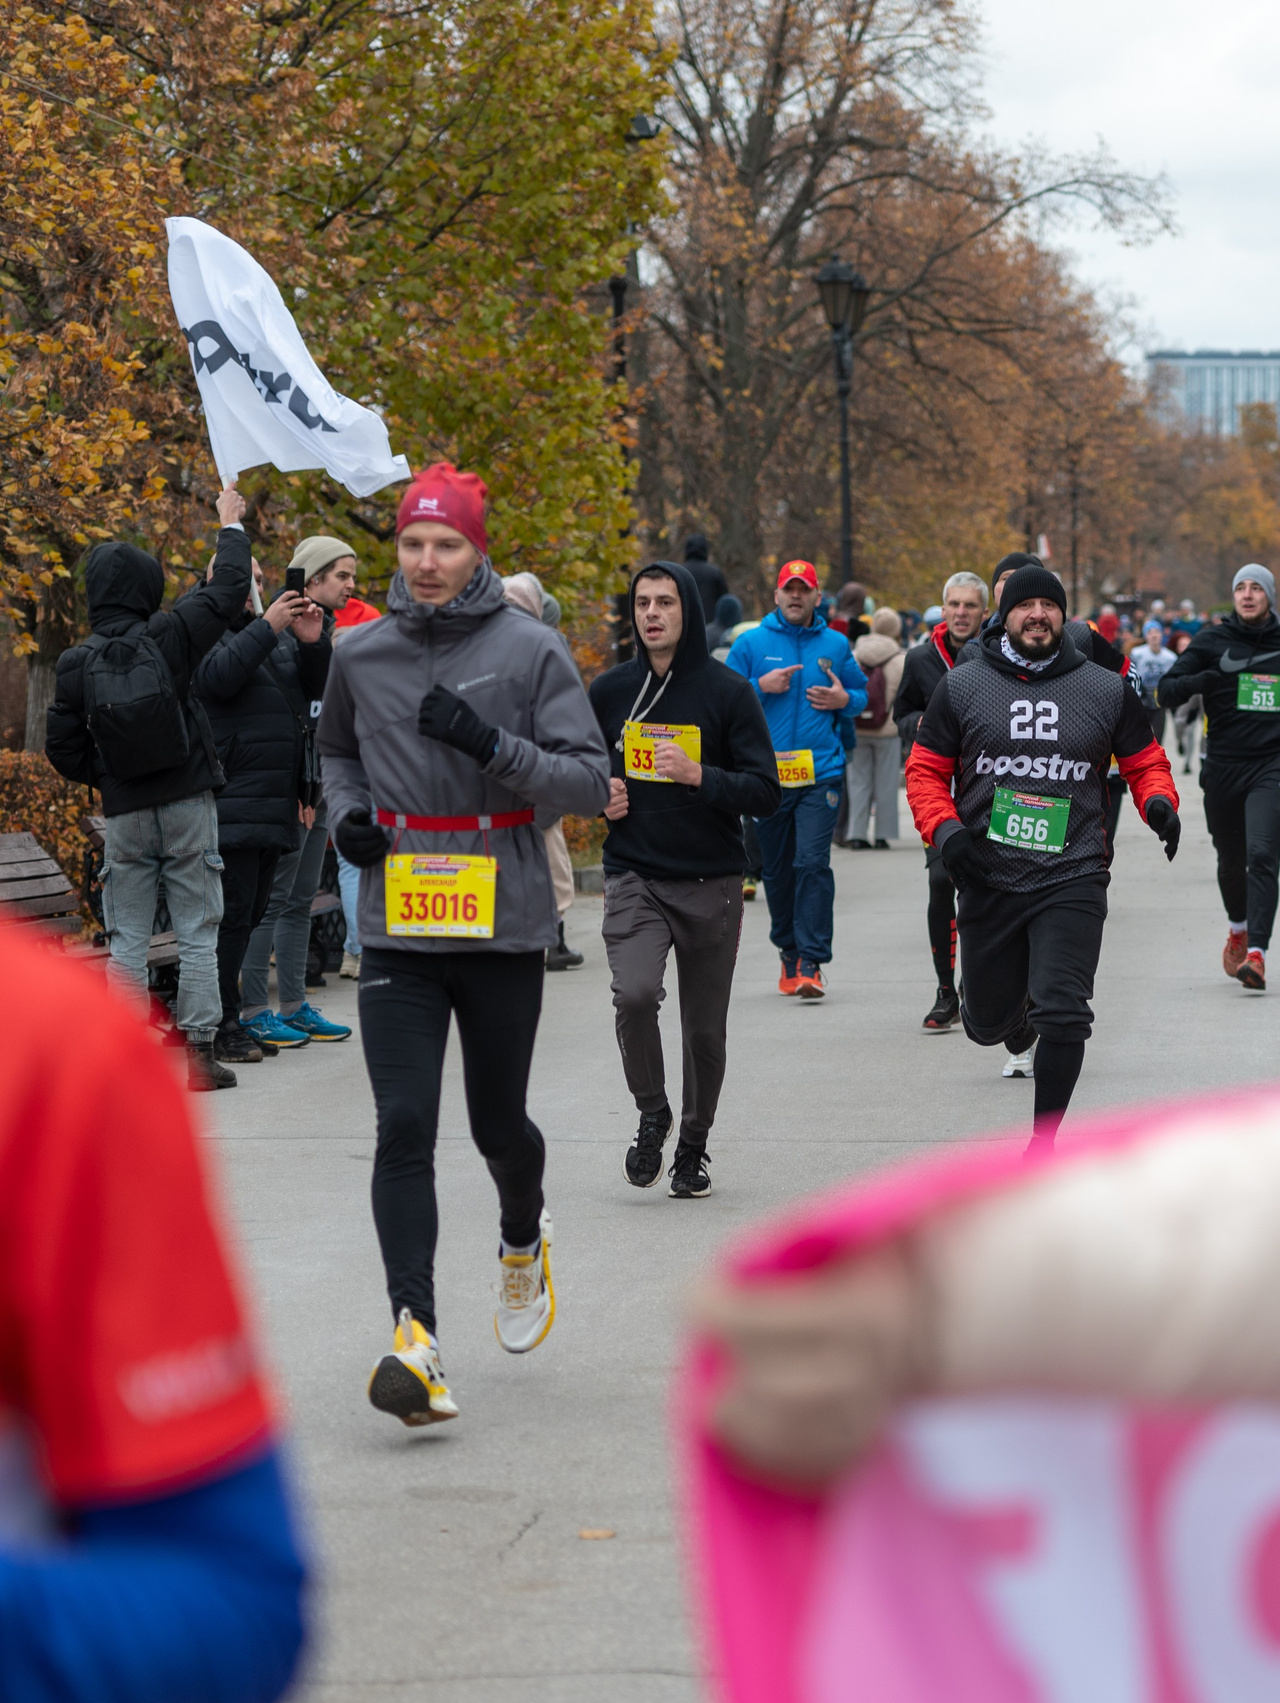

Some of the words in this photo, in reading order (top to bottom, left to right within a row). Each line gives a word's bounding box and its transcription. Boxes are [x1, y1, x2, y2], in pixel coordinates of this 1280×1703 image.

[1252, 691, 1275, 706] 513
[1010, 700, 1058, 741] 22
[632, 748, 655, 770] 33
[975, 750, 1091, 781] boostra
[1006, 814, 1049, 842] 656
[419, 879, 457, 887] АЛЕКСАНДР
[399, 892, 478, 922] 33016
